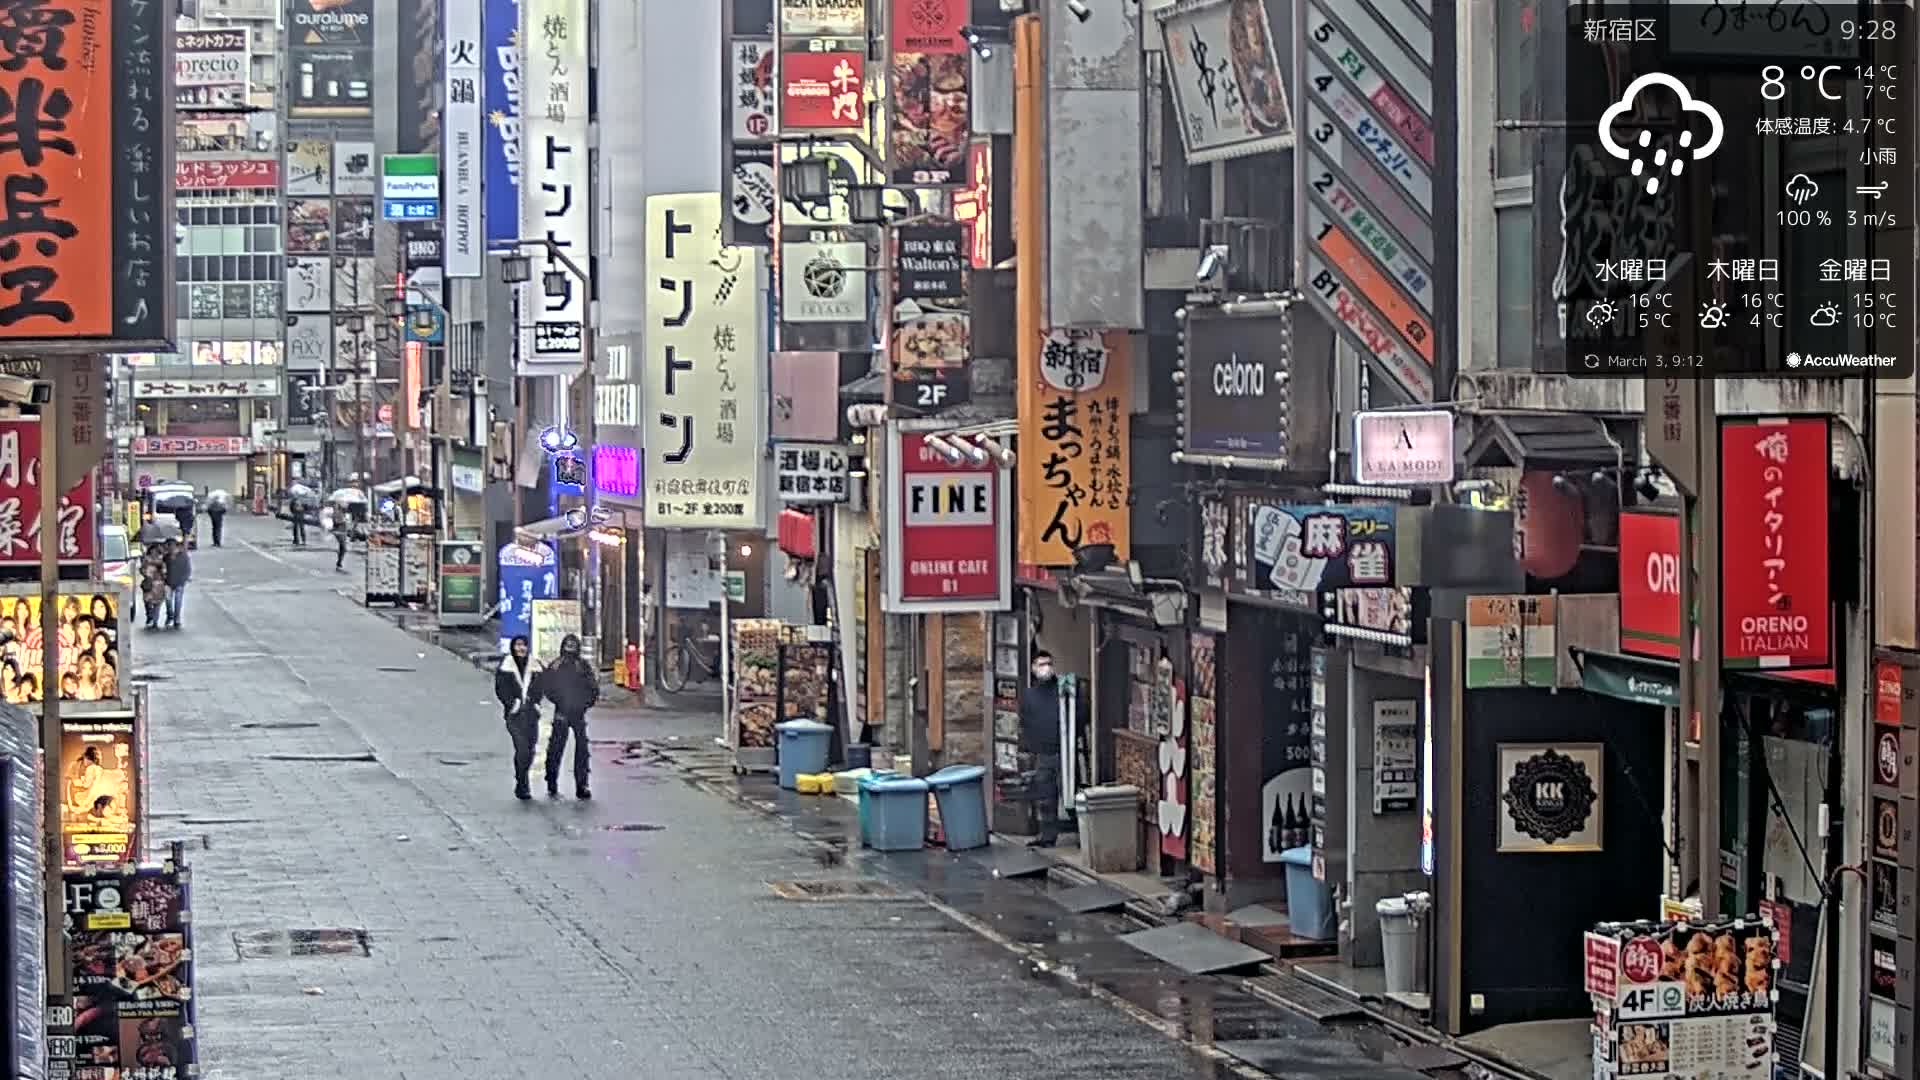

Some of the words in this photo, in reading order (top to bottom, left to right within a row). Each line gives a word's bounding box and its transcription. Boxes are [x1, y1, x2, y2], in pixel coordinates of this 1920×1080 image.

[296, 11, 369, 25] auralume
[1315, 23, 1335, 43] 5
[451, 40, 475, 104] 火鍋
[1314, 75, 1333, 92] 4
[1315, 123, 1334, 143] 3
[387, 181, 435, 192] FamilyMart
[1313, 173, 1333, 193] 2
[1317, 222, 1333, 240] 1
[1312, 270, 1340, 298] B1
[661, 210, 693, 463] トントン
[1213, 352, 1265, 396] celona
[917, 385, 947, 405] 2F
[779, 450, 844, 472] 酒場心
[1041, 396, 1086, 549] まっちゃん
[911, 484, 987, 514] FINE
[1351, 521, 1389, 534] フリー
[1755, 432, 1789, 604] 俺のイタリアン
[910, 558, 954, 576] ONLINE
[958, 558, 988, 575] CAFE
[1647, 552, 1680, 593] OR
[1741, 616, 1807, 633] ORENO
[1740, 634, 1808, 651] ITALIAN
[1536, 782, 1563, 799] KK
[1622, 989, 1655, 1012] 4F
